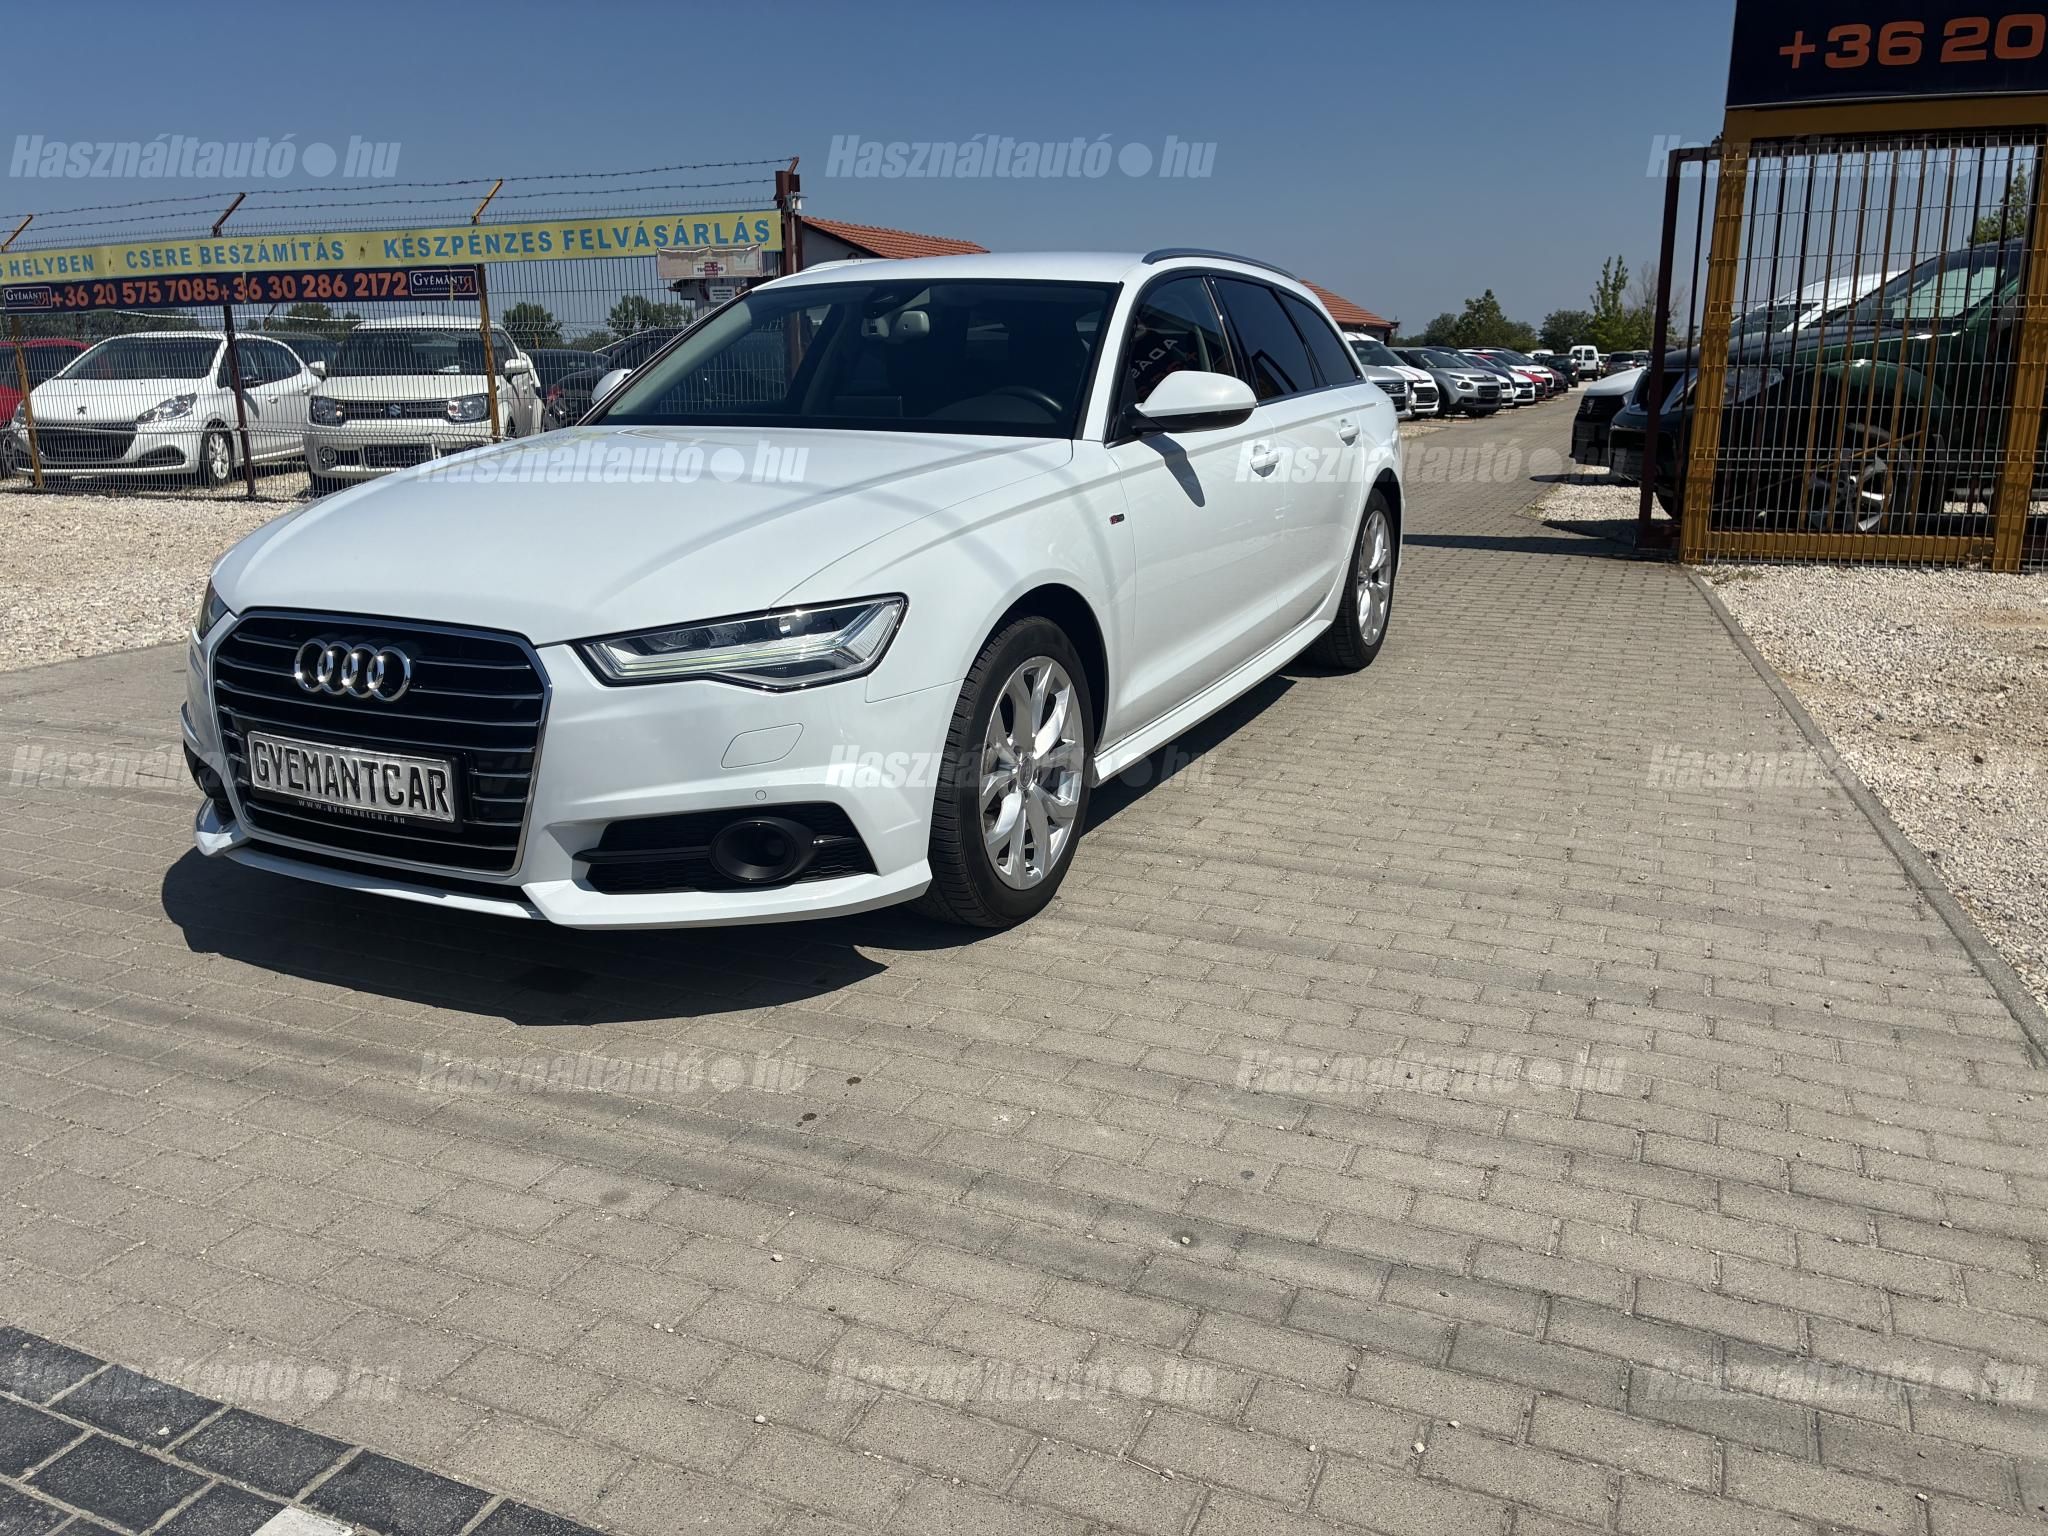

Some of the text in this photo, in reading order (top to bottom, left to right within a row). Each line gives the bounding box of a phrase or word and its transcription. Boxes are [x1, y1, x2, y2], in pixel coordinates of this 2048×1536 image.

[1779, 14, 2047, 69] +36 20
[9, 254, 95, 277] HELYBEN
[126, 248, 193, 269] CSERE
[200, 237, 345, 264] BESZÁMÍTÁS
[383, 229, 553, 259] KÉSZPÉNZES
[563, 216, 770, 250] FELVÁSÁRLÁS
[53, 285, 89, 307] +36
[93, 283, 117, 305] 20
[122, 281, 161, 304] 575
[165, 278, 220, 303] 7085
[267, 275, 296, 299] 30
[301, 272, 348, 298] 286
[353, 271, 409, 297] 2172
[253, 740, 448, 813] GYEMANTCAR
